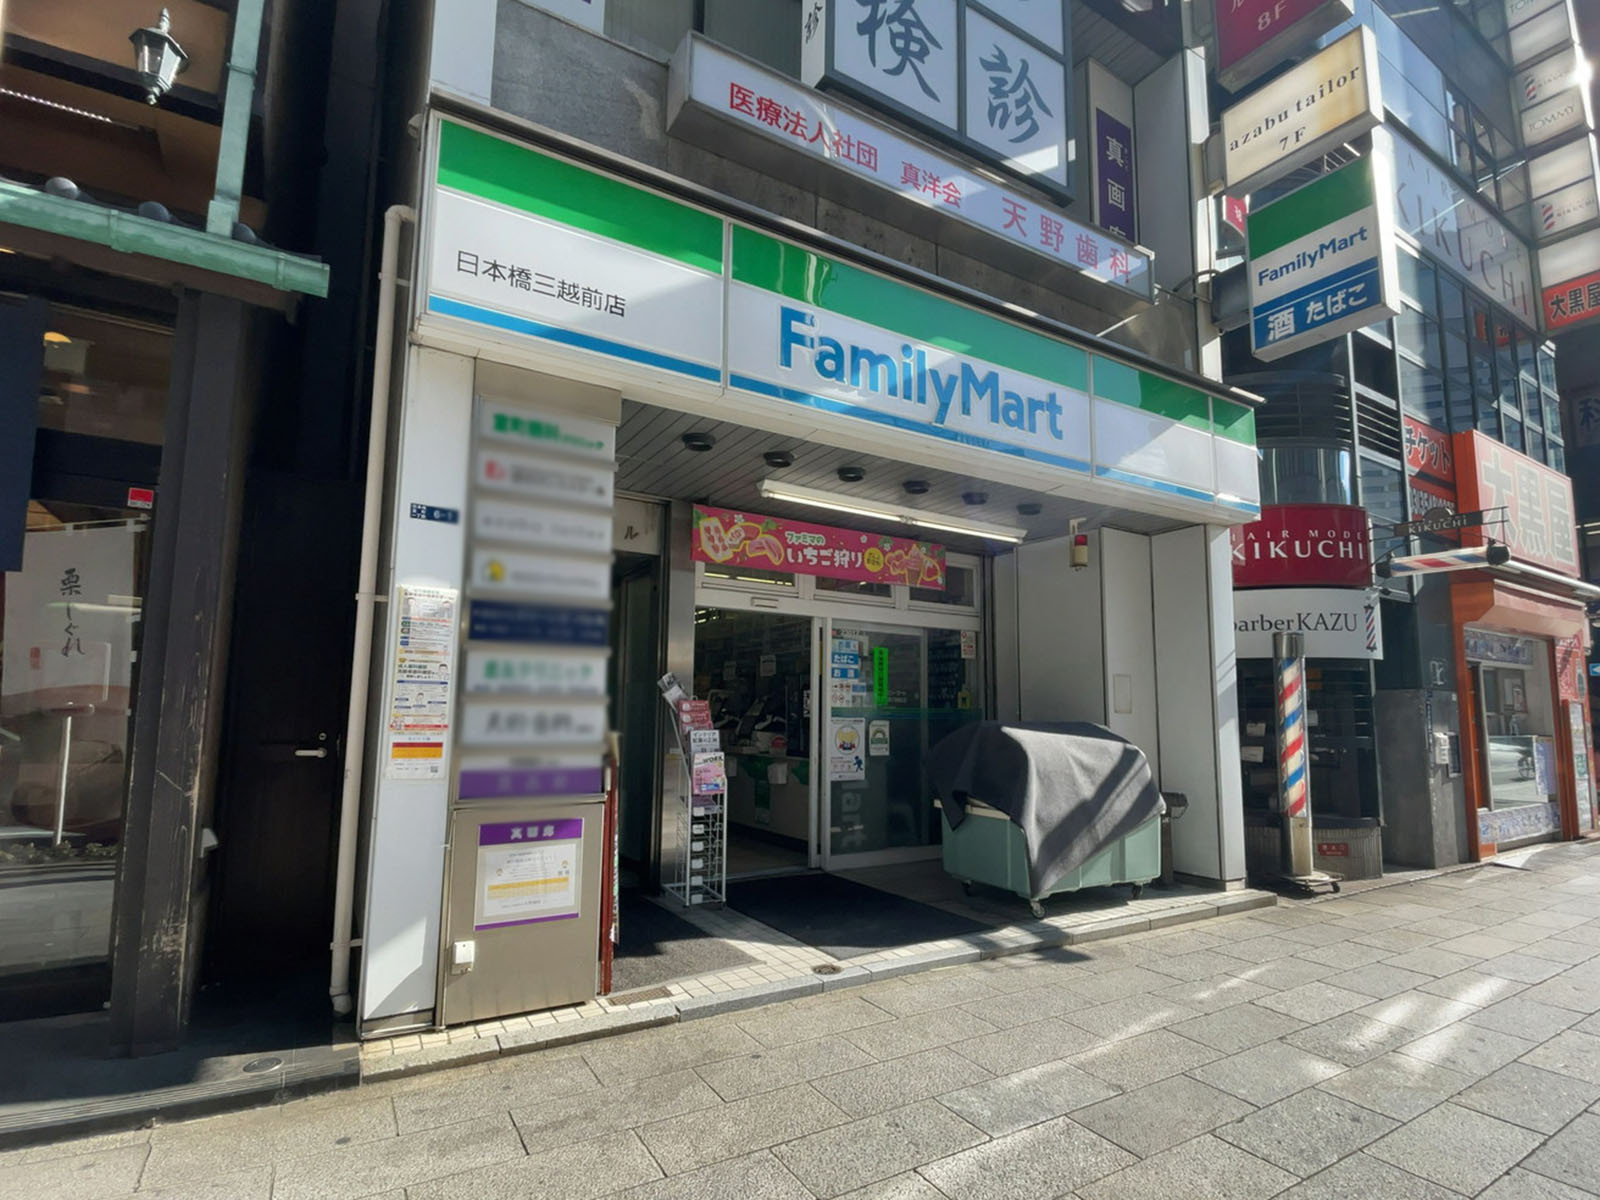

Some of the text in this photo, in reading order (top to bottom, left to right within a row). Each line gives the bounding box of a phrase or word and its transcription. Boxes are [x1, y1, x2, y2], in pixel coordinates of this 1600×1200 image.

[1257, 1, 1287, 31] 8F
[1229, 66, 1360, 152] azabu tailor
[730, 82, 1131, 284] 医療法人社団 真洋会 天野歯科
[456, 250, 626, 317] 日本橋三越前店
[1258, 226, 1368, 286] FamilyMart
[1267, 282, 1367, 341] 酒 たばこ
[779, 305, 1064, 441] FamilyMart
[1404, 425, 1451, 474] チケット
[1308, 529, 1363, 540] MODE
[1408, 516, 1467, 534] KIKUCHI
[1481, 447, 1576, 566] 大黒屋
[785, 531, 826, 546] ファミマの
[786, 547, 863, 569] いちご狩り
[60, 567, 86, 659] 栗しぐれ
